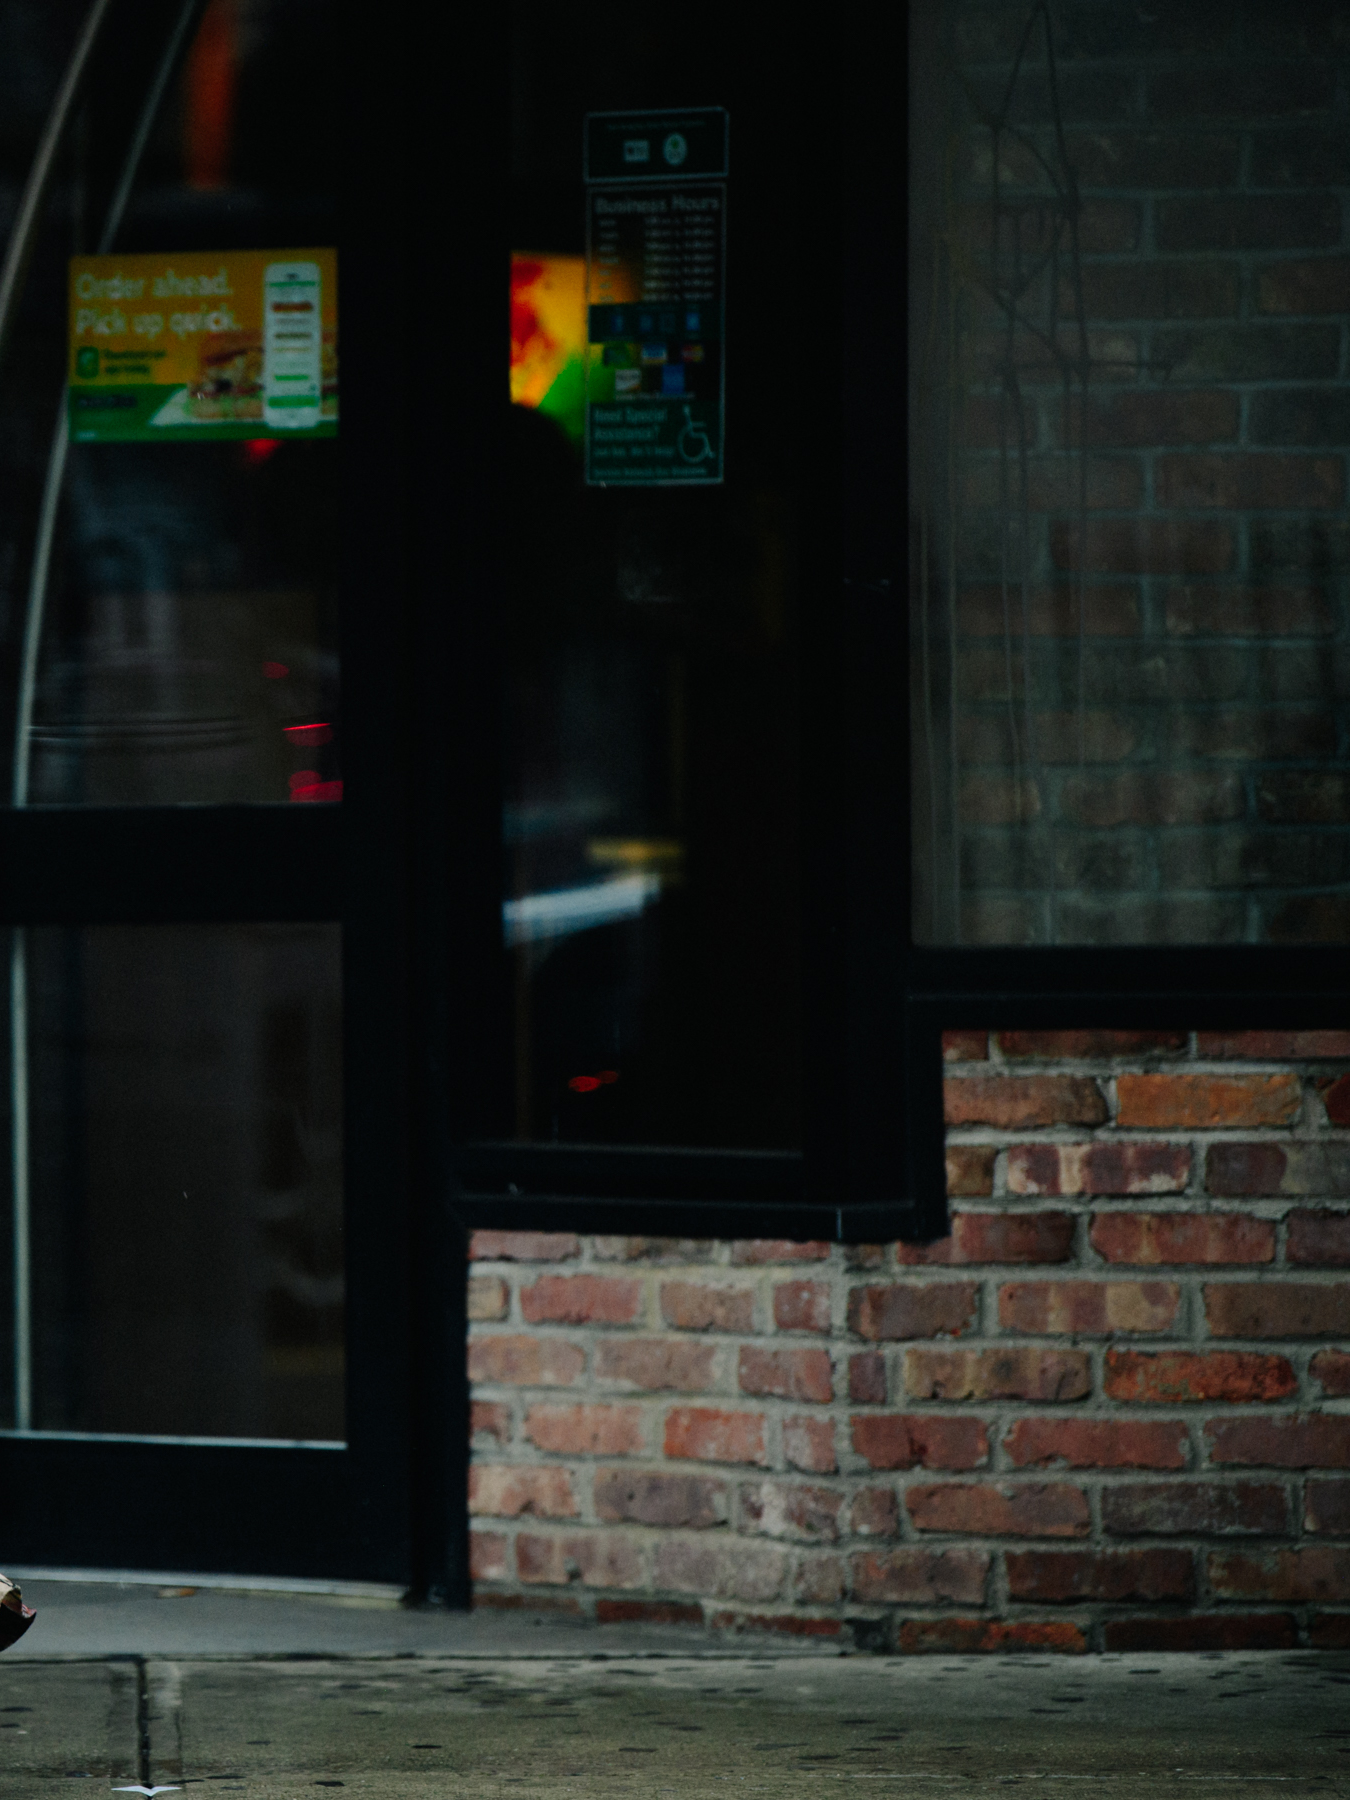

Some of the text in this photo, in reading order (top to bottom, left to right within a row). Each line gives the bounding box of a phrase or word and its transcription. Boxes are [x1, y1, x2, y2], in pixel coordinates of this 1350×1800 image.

[671, 194, 720, 211] Hours
[76, 267, 234, 301] Order ahead.
[76, 306, 127, 335] Pick
[133, 312, 165, 341] up
